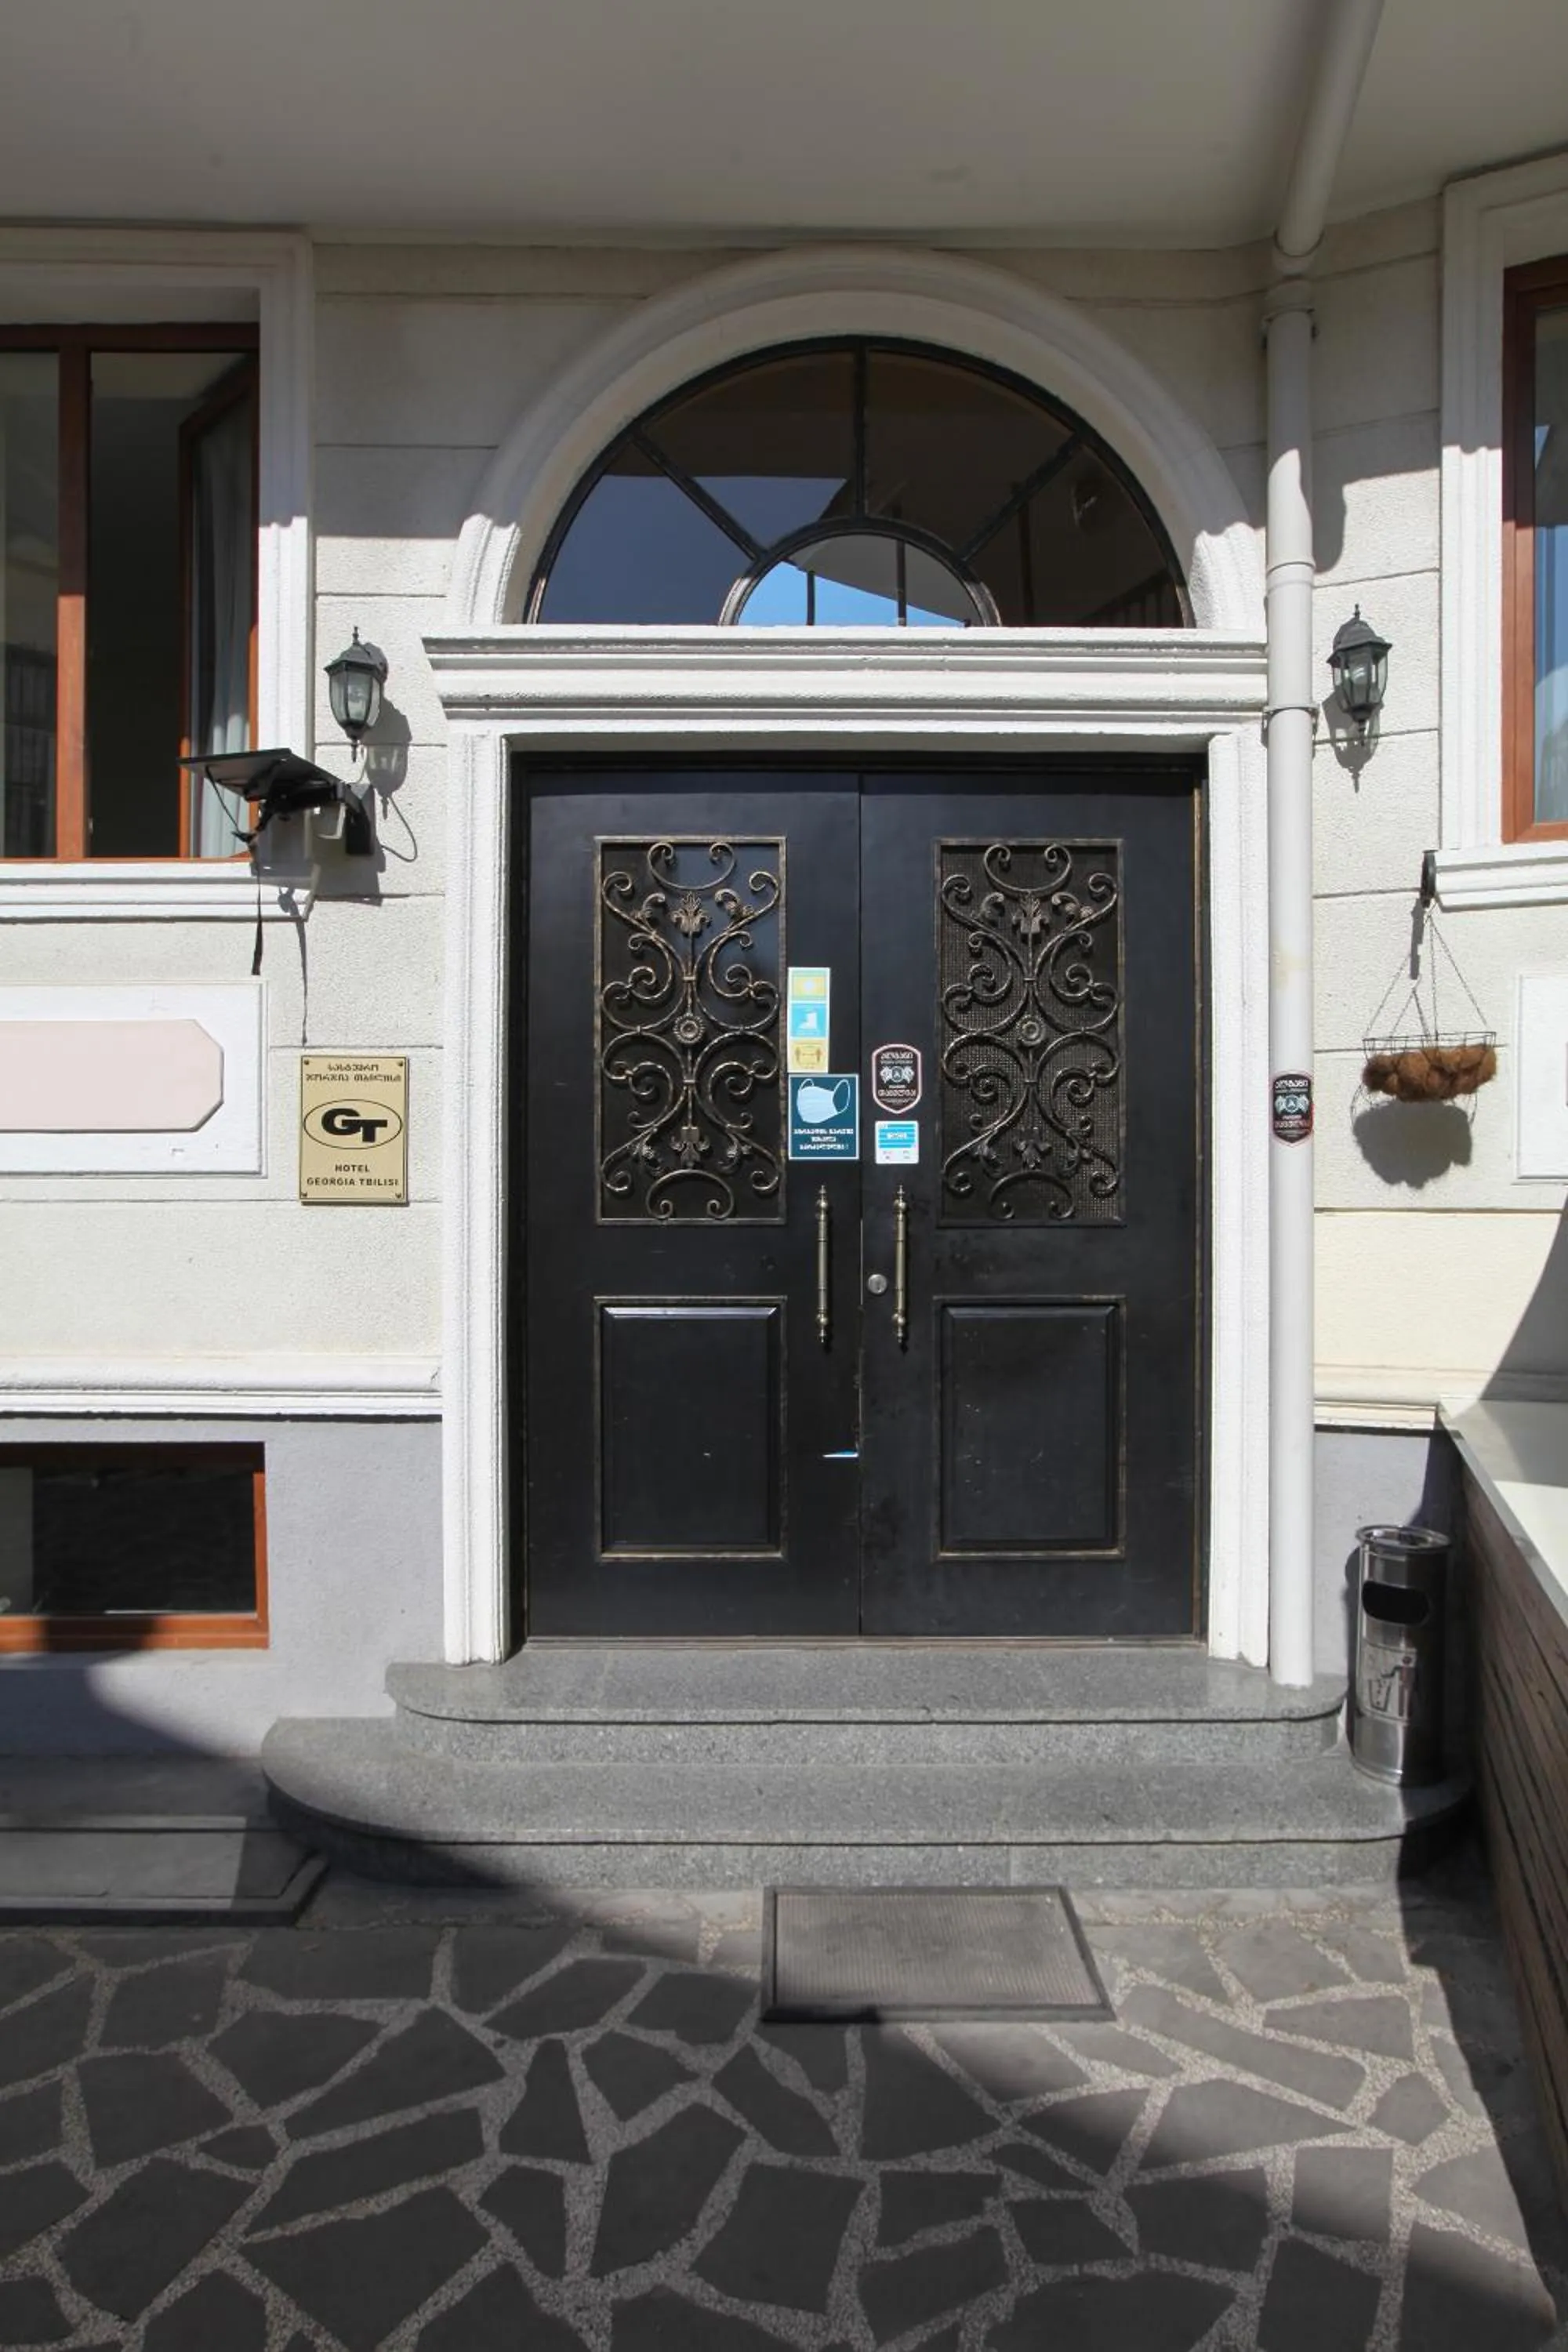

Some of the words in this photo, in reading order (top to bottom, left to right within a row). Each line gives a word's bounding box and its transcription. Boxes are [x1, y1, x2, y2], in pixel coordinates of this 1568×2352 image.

[321, 1108, 388, 1143] GT
[335, 1164, 370, 1173] HOTEL
[307, 1177, 355, 1186] GEORGIA
[359, 1178, 399, 1186] TBILISI
